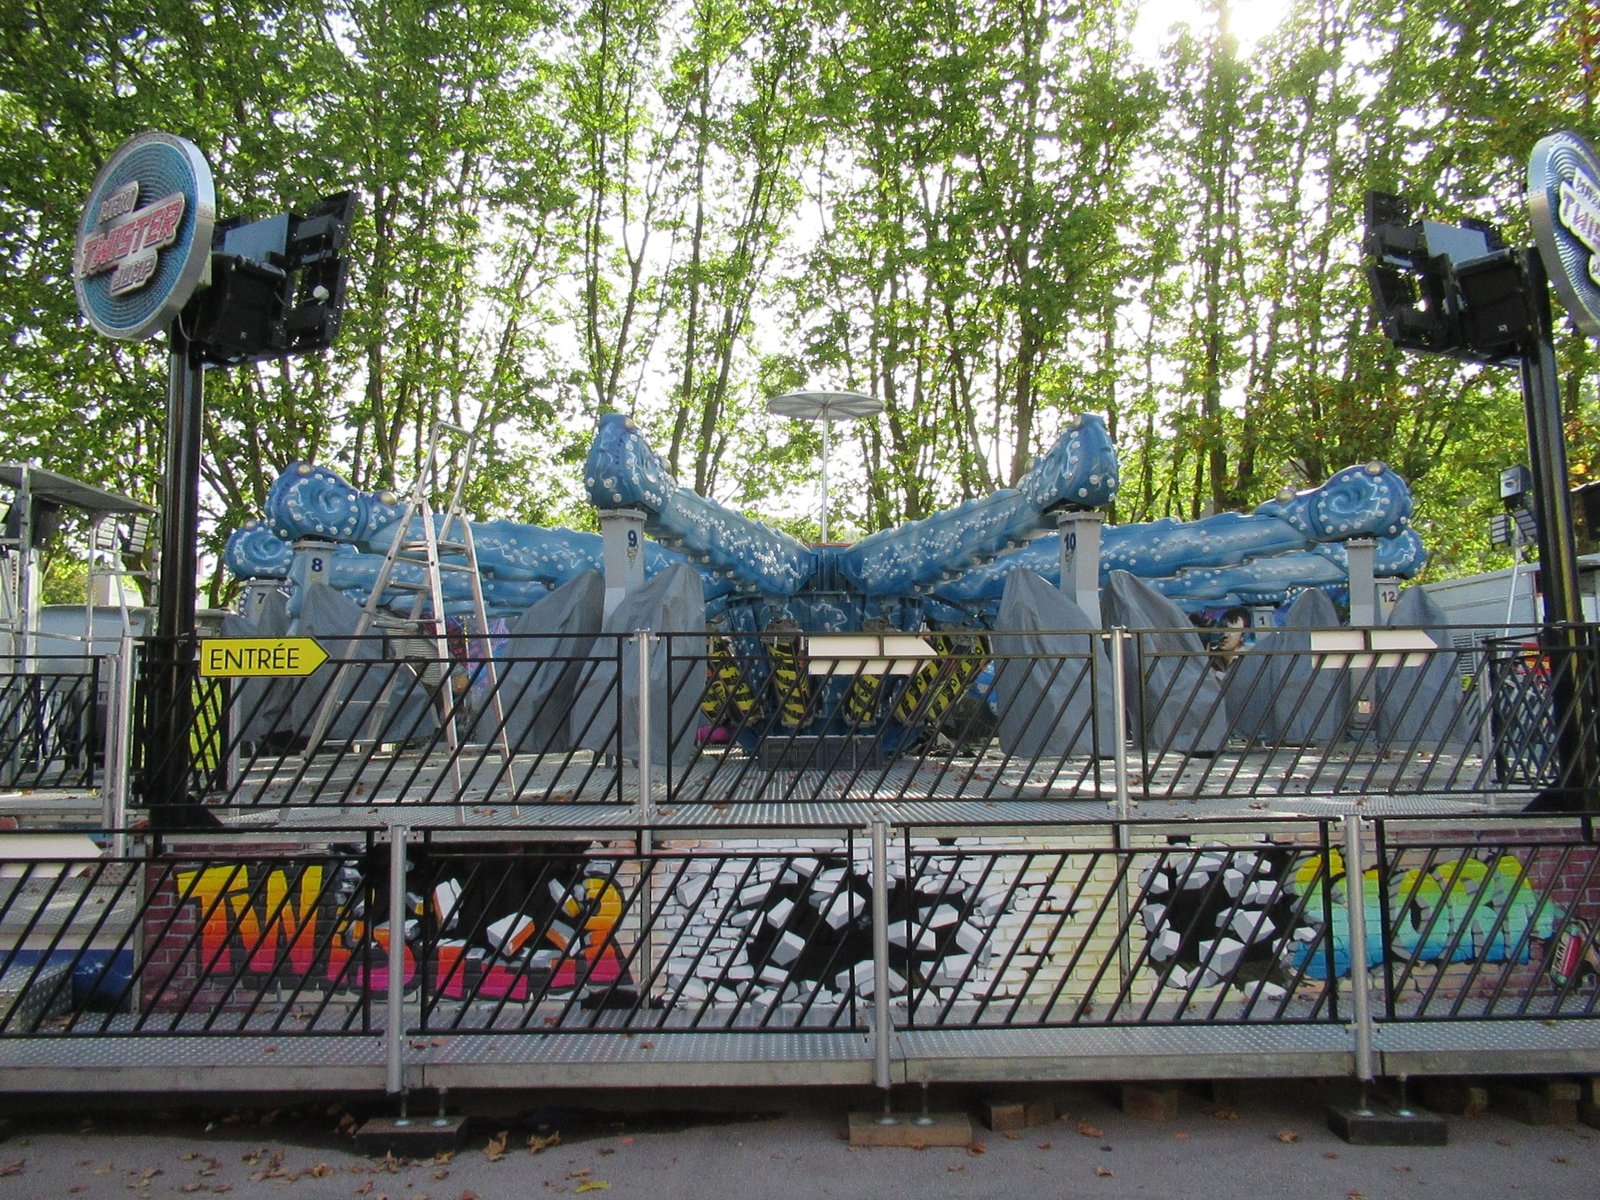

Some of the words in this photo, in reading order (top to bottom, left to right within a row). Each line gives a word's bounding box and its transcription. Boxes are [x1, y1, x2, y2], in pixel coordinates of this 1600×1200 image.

[81, 200, 182, 273] TWISTER
[112, 254, 155, 291] JUMP
[627, 529, 638, 547] 9
[1064, 532, 1077, 551] 10
[311, 557, 323, 572] 8
[257, 592, 266, 604] 7
[1381, 591, 1395, 603] 12
[1258, 616, 1265, 625] 1
[210, 642, 299, 669] ENTRÉE
